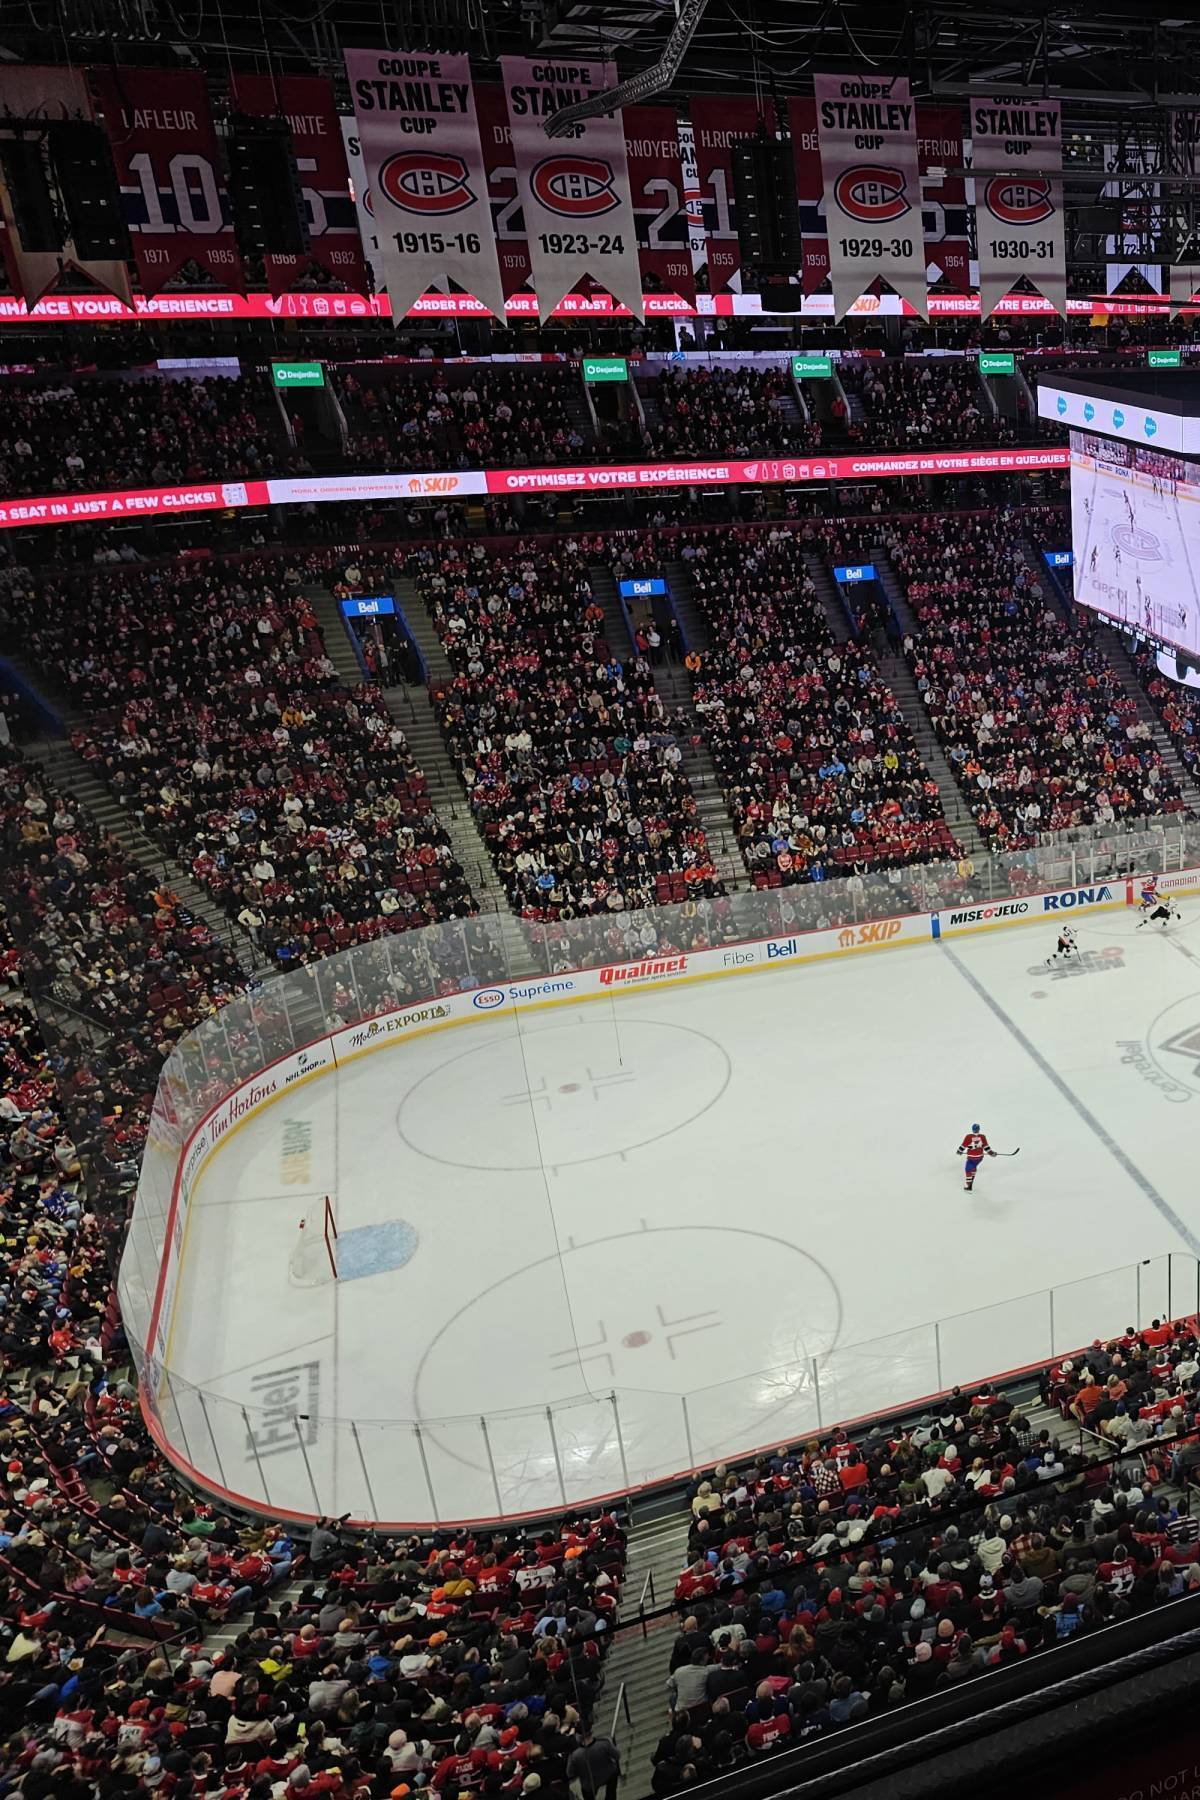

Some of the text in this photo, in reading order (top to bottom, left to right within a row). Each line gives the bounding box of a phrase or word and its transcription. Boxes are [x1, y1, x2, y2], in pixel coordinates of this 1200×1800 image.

[378, 59, 441, 78] COUPE
[532, 65, 591, 85] COUPE
[356, 80, 469, 114] STANLEY
[840, 83, 891, 99] COUPE
[121, 109, 198, 130] LAFLEUR
[821, 101, 912, 131] STANLEY
[976, 108, 1057, 136] STANLEY
[400, 117, 437, 134] CUP
[854, 134, 885, 149] CUP
[1004, 140, 1032, 155] CUP
[129, 153, 225, 234] 10
[392, 232, 481, 254] 1915-16
[538, 234, 625, 255] 1923-24
[839, 239, 913, 257] 1929-30
[989, 240, 1054, 259] 1930-31
[143, 249, 170, 263] 1971
[206, 249, 234, 263] 1985
[330, 250, 356, 264] 1982
[503, 256, 526, 268] 1970
[712, 252, 734, 265] 1955
[806, 254, 827, 266] 1950
[944, 255, 964, 268] 1964
[667, 263, 688, 276] 1979
[73, 300, 123, 314] YOUR
[412, 300, 608, 311] ORDER IN JUST
[853, 298, 880, 312] SKIP
[926, 299, 981, 311] PTIMISEZ
[596, 366, 624, 374] Desjardins
[803, 363, 828, 371] Desjardins
[989, 360, 1012, 368] Desjardins
[287, 369, 320, 379] Desjardins
[852, 454, 1066, 472] COMMANDEZ DE VOTRE SIÈGE EN QUELQUES
[424, 477, 460, 492] SKIP
[507, 467, 730, 488] OPTIMISEZ VOTRE EXPÉRIENCE!
[9, 492, 216, 520] SEAT IN JUST A FEW CLICKS!
[1055, 554, 1070, 564] Bell
[845, 567, 864, 580] Bell
[633, 582, 652, 595] Bell
[357, 600, 379, 615] Bell
[1160, 874, 1197, 889] CANADIAN
[1043, 886, 1113, 911] RONA
[857, 921, 902, 945] SKIP
[723, 939, 797, 966] Fibe Bell
[599, 956, 688, 985] Qualinet
[509, 980, 574, 1001] Suprême
[349, 1008, 436, 1047] Molson EXPORT
[208, 1080, 278, 1143] Tim Hortons
[524, 1576, 543, 1589] 22
[1150, 1768, 1189, 1796] NOT
